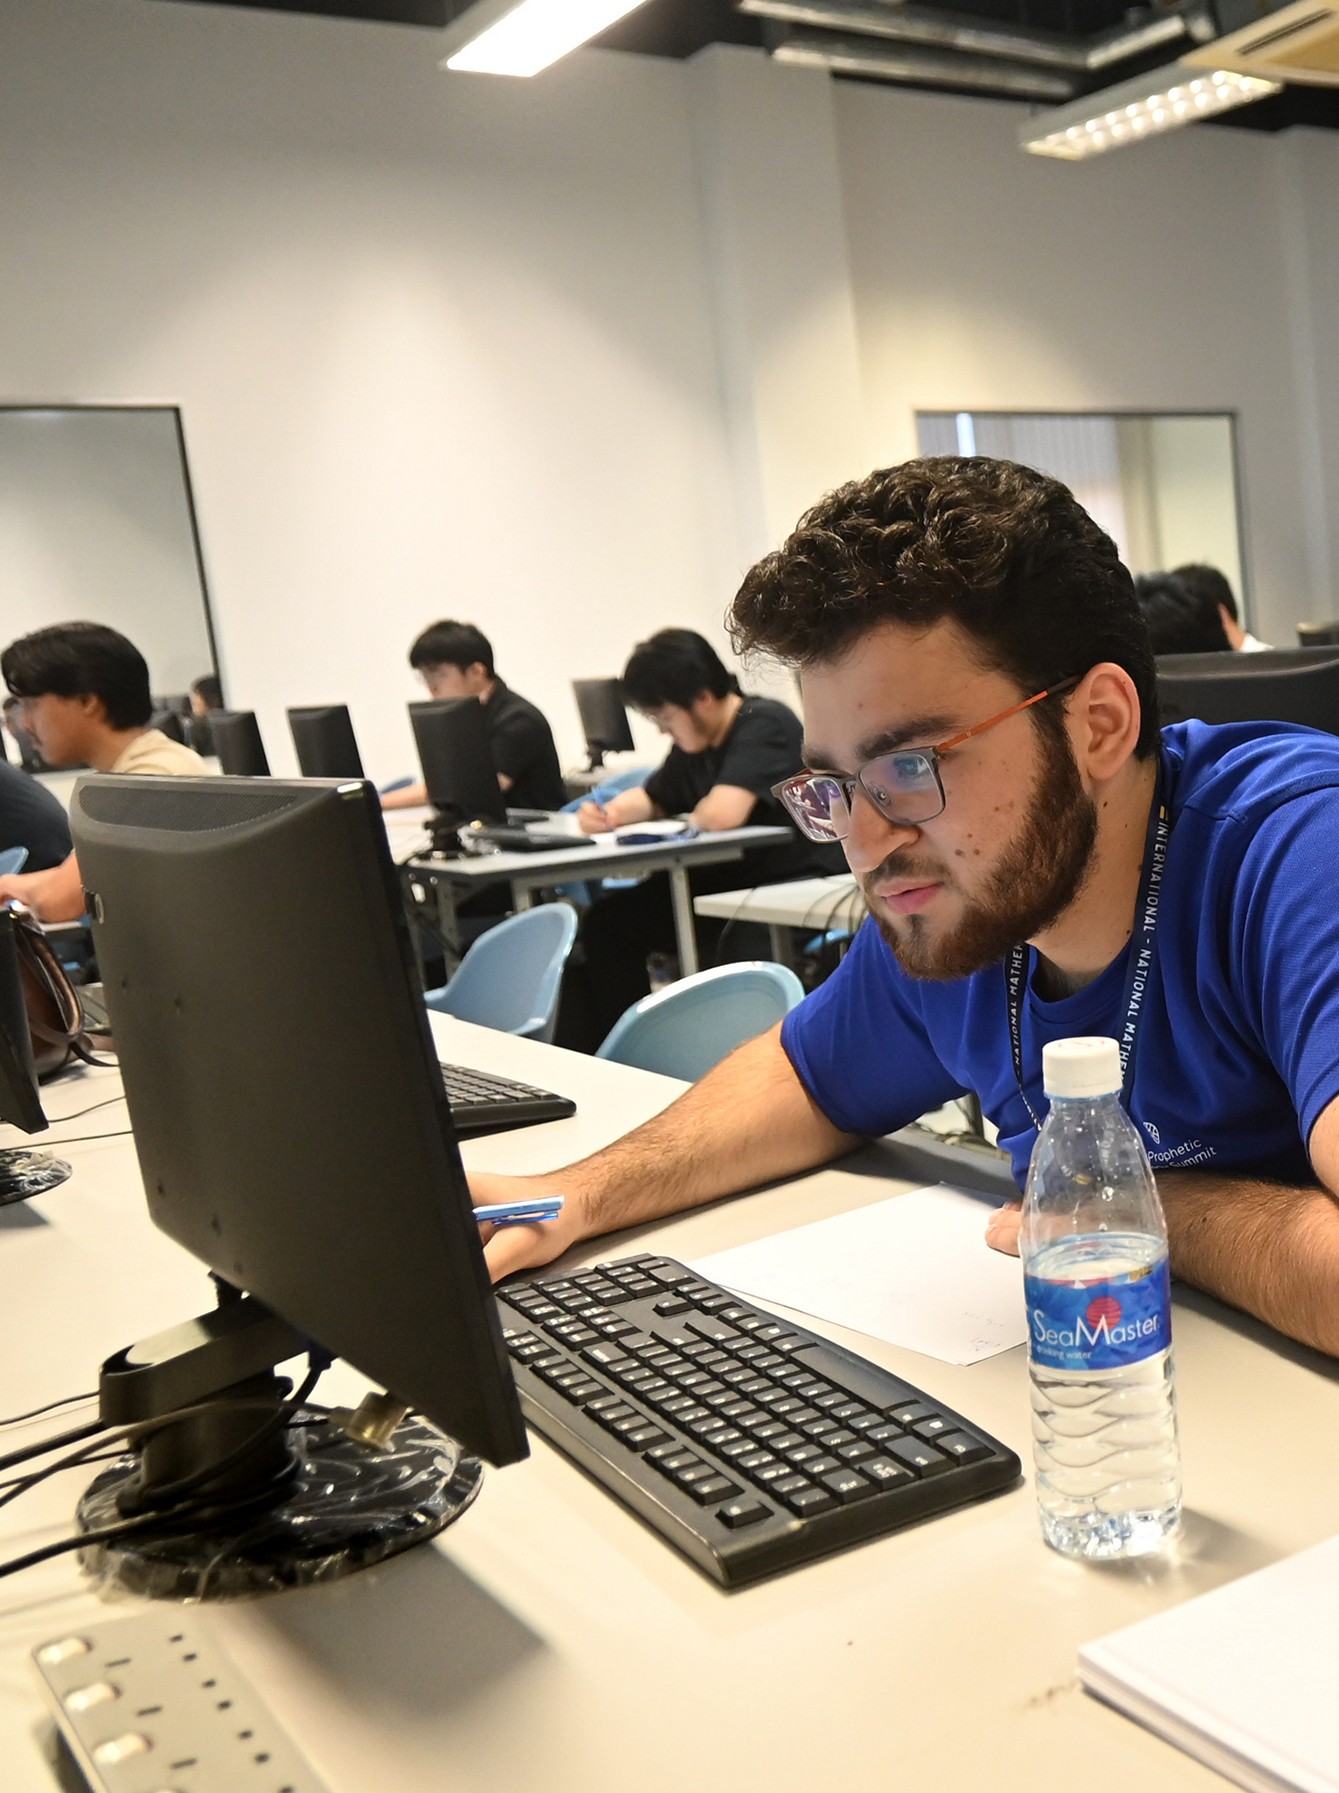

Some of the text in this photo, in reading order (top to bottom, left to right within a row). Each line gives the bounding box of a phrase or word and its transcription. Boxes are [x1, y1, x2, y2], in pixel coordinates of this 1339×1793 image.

[1143, 818, 1169, 932] INTERNATIONAL
[1127, 950, 1151, 1018] NATIONAL
[1008, 1000, 1022, 1066] NATIONAL
[1119, 1022, 1136, 1080] MATHE
[1147, 1139, 1202, 1163] Prophetic
[1168, 1146, 1217, 1169] Summit
[1033, 1309, 1158, 1347] SeaMaster
[1066, 1350, 1093, 1360] water
